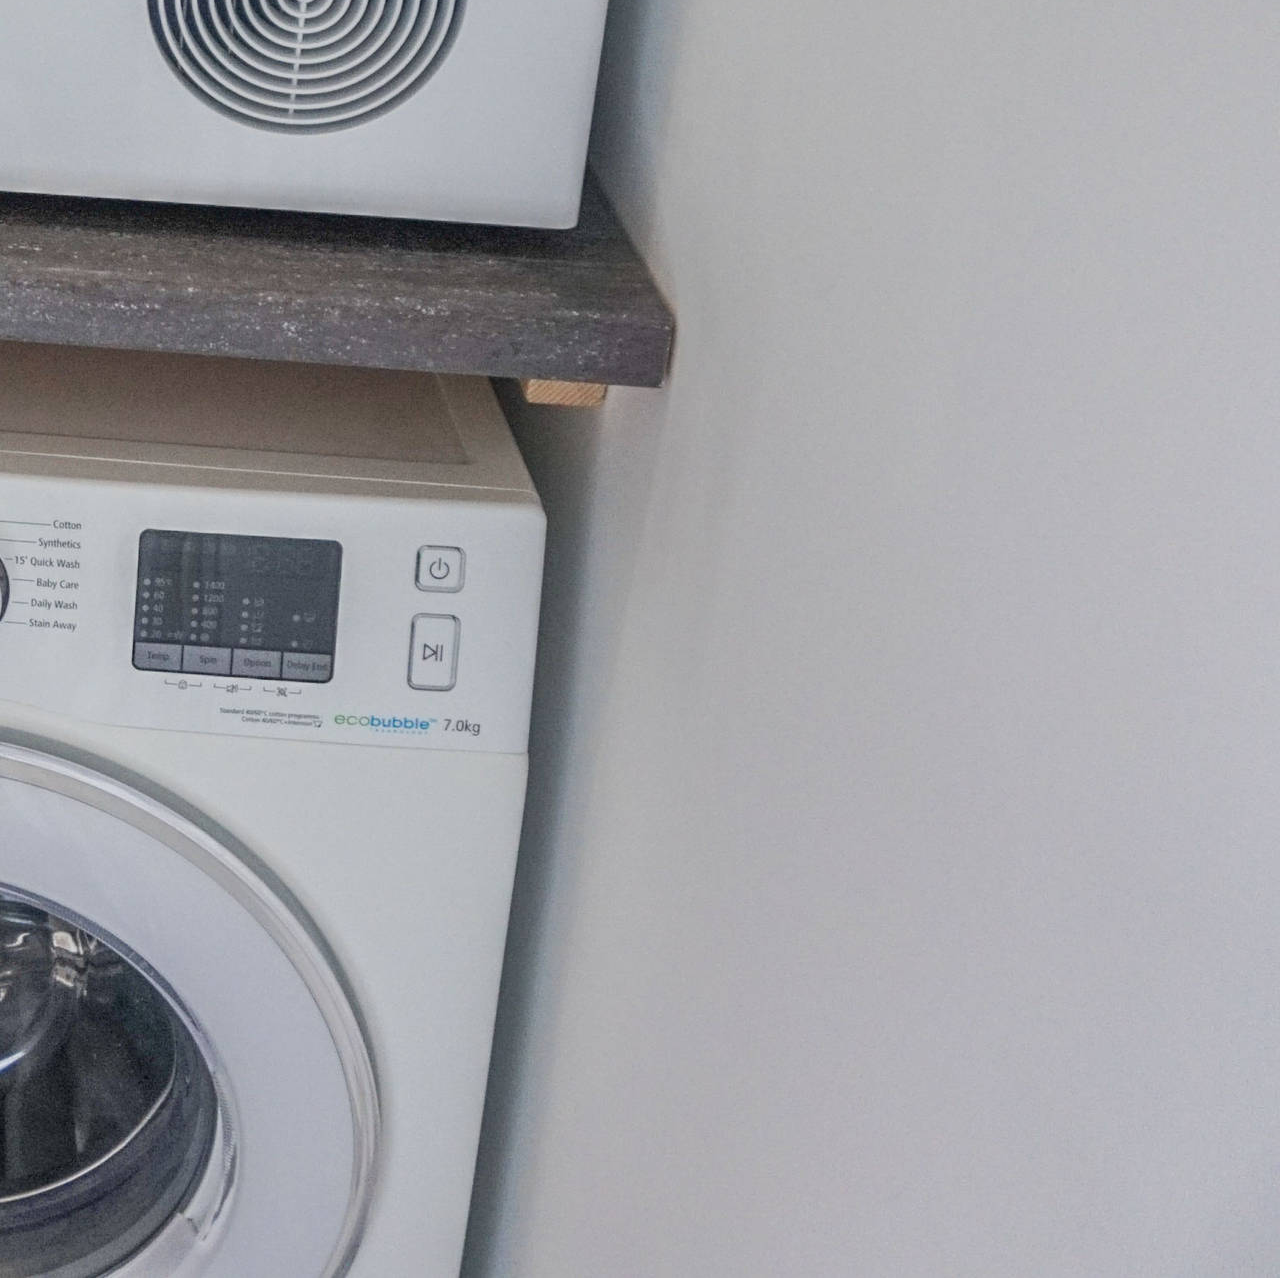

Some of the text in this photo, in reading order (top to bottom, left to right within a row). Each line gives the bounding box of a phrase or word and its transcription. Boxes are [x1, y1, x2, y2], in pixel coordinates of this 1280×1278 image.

[53, 520, 82, 530] Cotton
[38, 537, 81, 550] Synthetics
[30, 556, 54, 568] Quick
[57, 558, 80, 569] Wash
[36, 577, 79, 590] Baby Care
[30, 598, 78, 610] Daily Wash
[29, 618, 78, 632] Stain Away
[199, 655, 217, 666] Spin
[244, 658, 272, 669] Option
[287, 660, 328, 671] Delay End
[443, 718, 481, 737] 7.0kg
